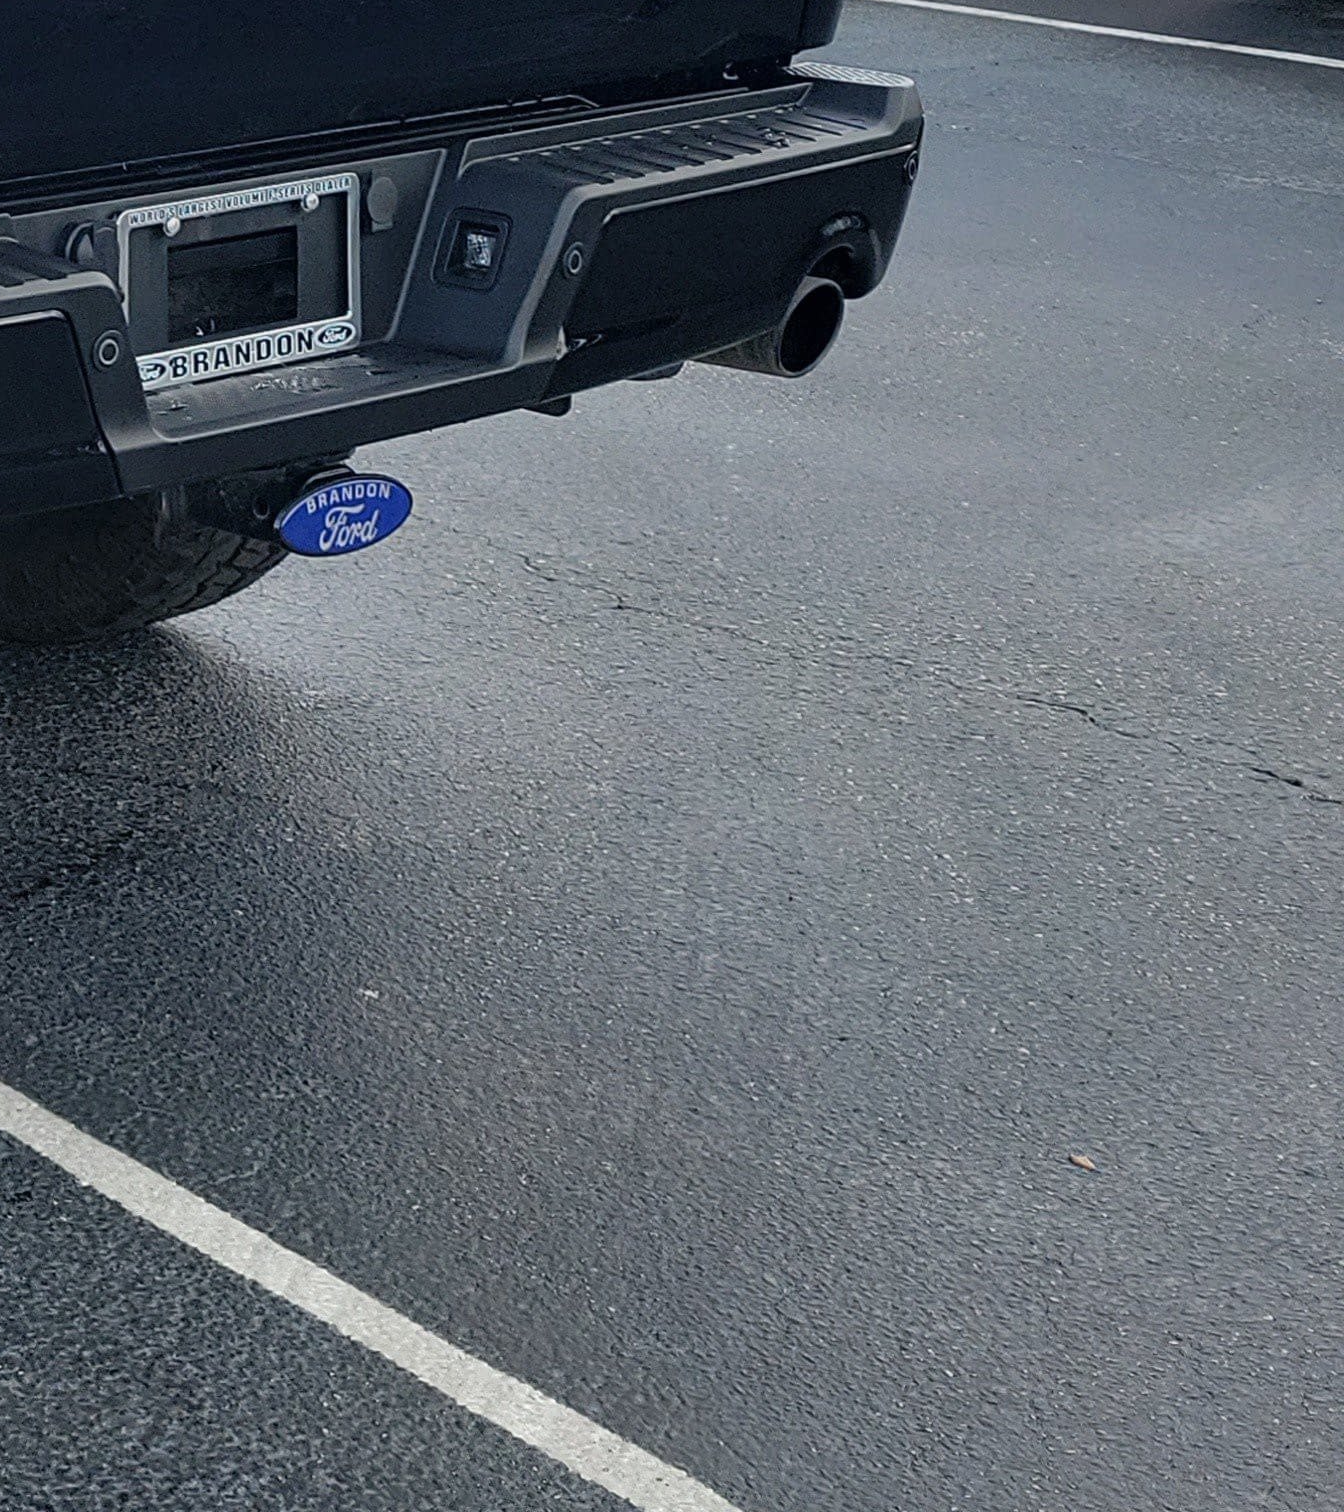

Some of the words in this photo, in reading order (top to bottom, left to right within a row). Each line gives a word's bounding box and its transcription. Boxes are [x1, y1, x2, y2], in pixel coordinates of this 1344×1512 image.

[314, 175, 352, 192] DEALER
[169, 329, 313, 379] BRANDON
[306, 483, 392, 514] BRANDON
[319, 503, 380, 552] Ford
